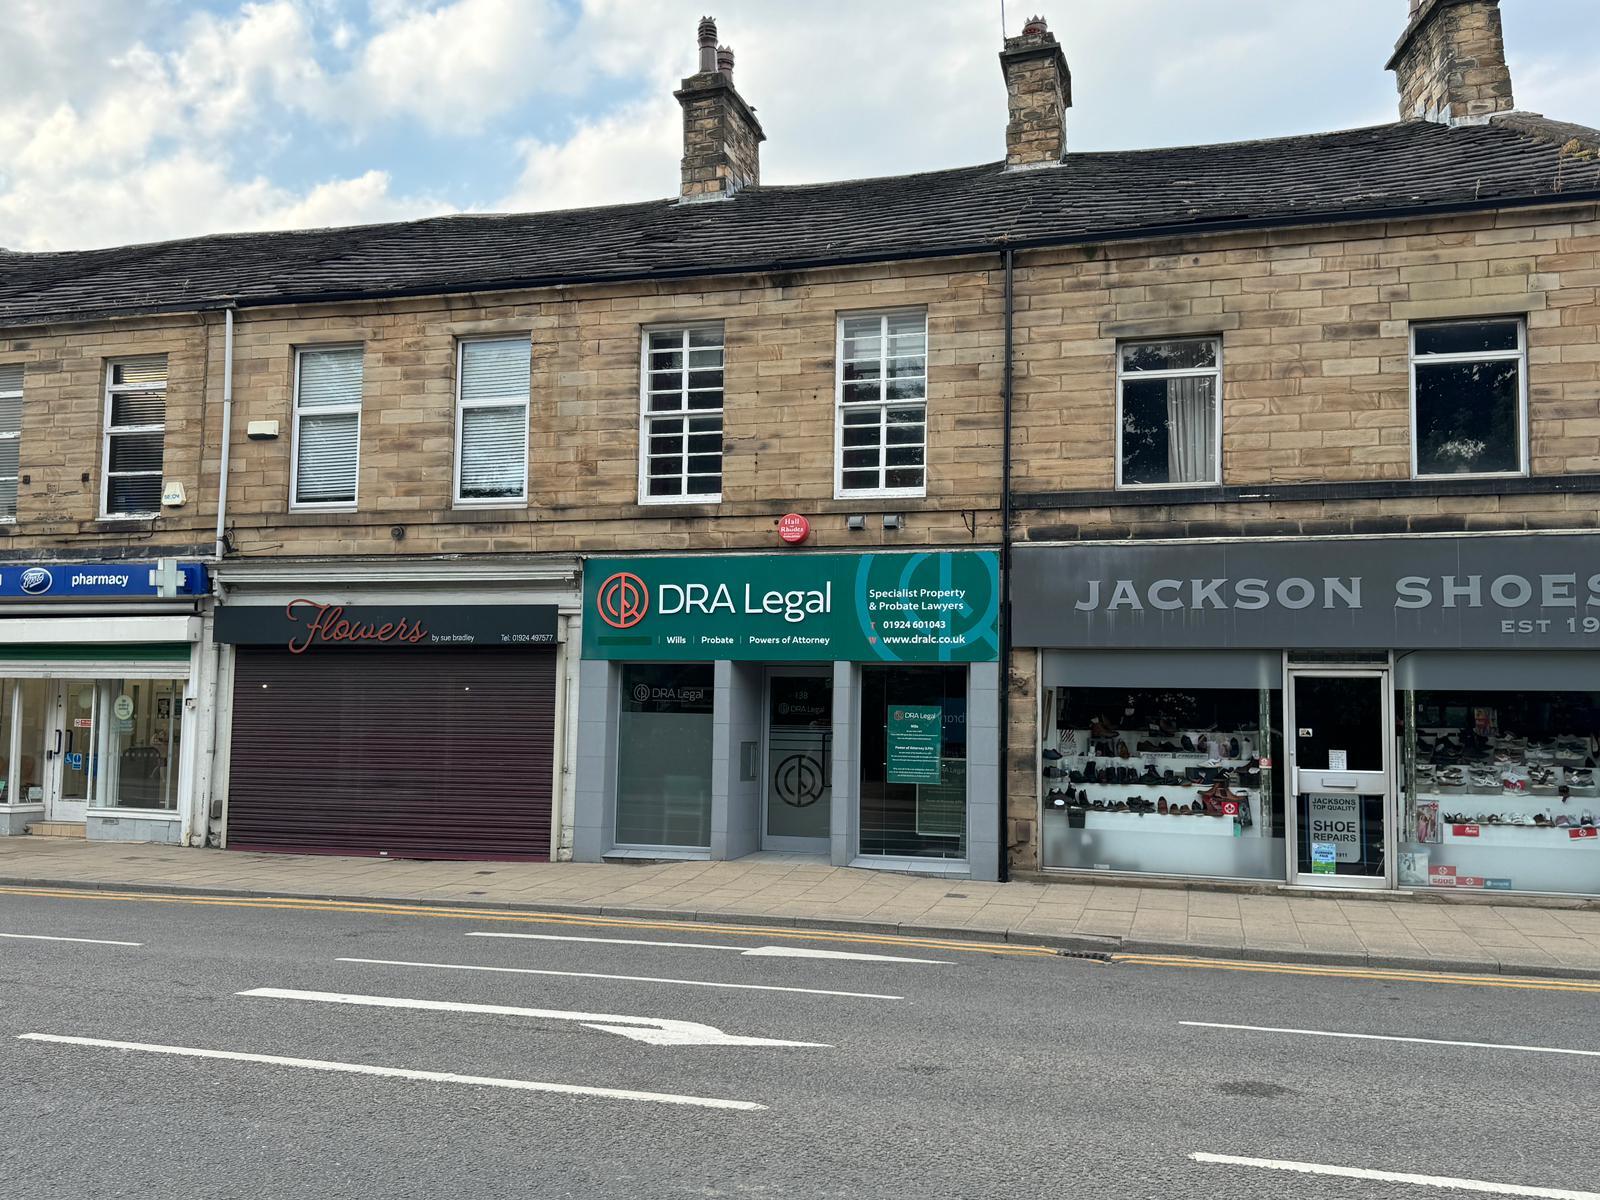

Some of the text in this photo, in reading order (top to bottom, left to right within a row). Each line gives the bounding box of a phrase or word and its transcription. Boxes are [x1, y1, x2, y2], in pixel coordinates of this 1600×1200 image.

[71, 573, 129, 587] pharmacy
[869, 589, 965, 599] Specialist Property
[1074, 577, 1363, 611] JACKSON
[658, 581, 832, 623] DRA Legal
[868, 602, 964, 612] & Probate Lawyers
[286, 598, 427, 653] Flowers
[870, 620, 946, 630] T 01924 601043
[1501, 619, 1551, 633] EST
[431, 633, 440, 642] by
[452, 633, 475, 642] bradley
[501, 633, 511, 641] Tel:
[666, 635, 687, 645] Wills
[701, 636, 734, 645] Probate
[749, 636, 831, 646] Powers of Attorney
[883, 634, 966, 644] www.dralc.co.uk
[652, 688, 704, 701] DRA Legal
[790, 704, 825, 715] DRA Legal
[920, 713, 936, 721] Legal
[1313, 820, 1356, 833] SHOE
[1313, 833, 1357, 842] REPAIRS
